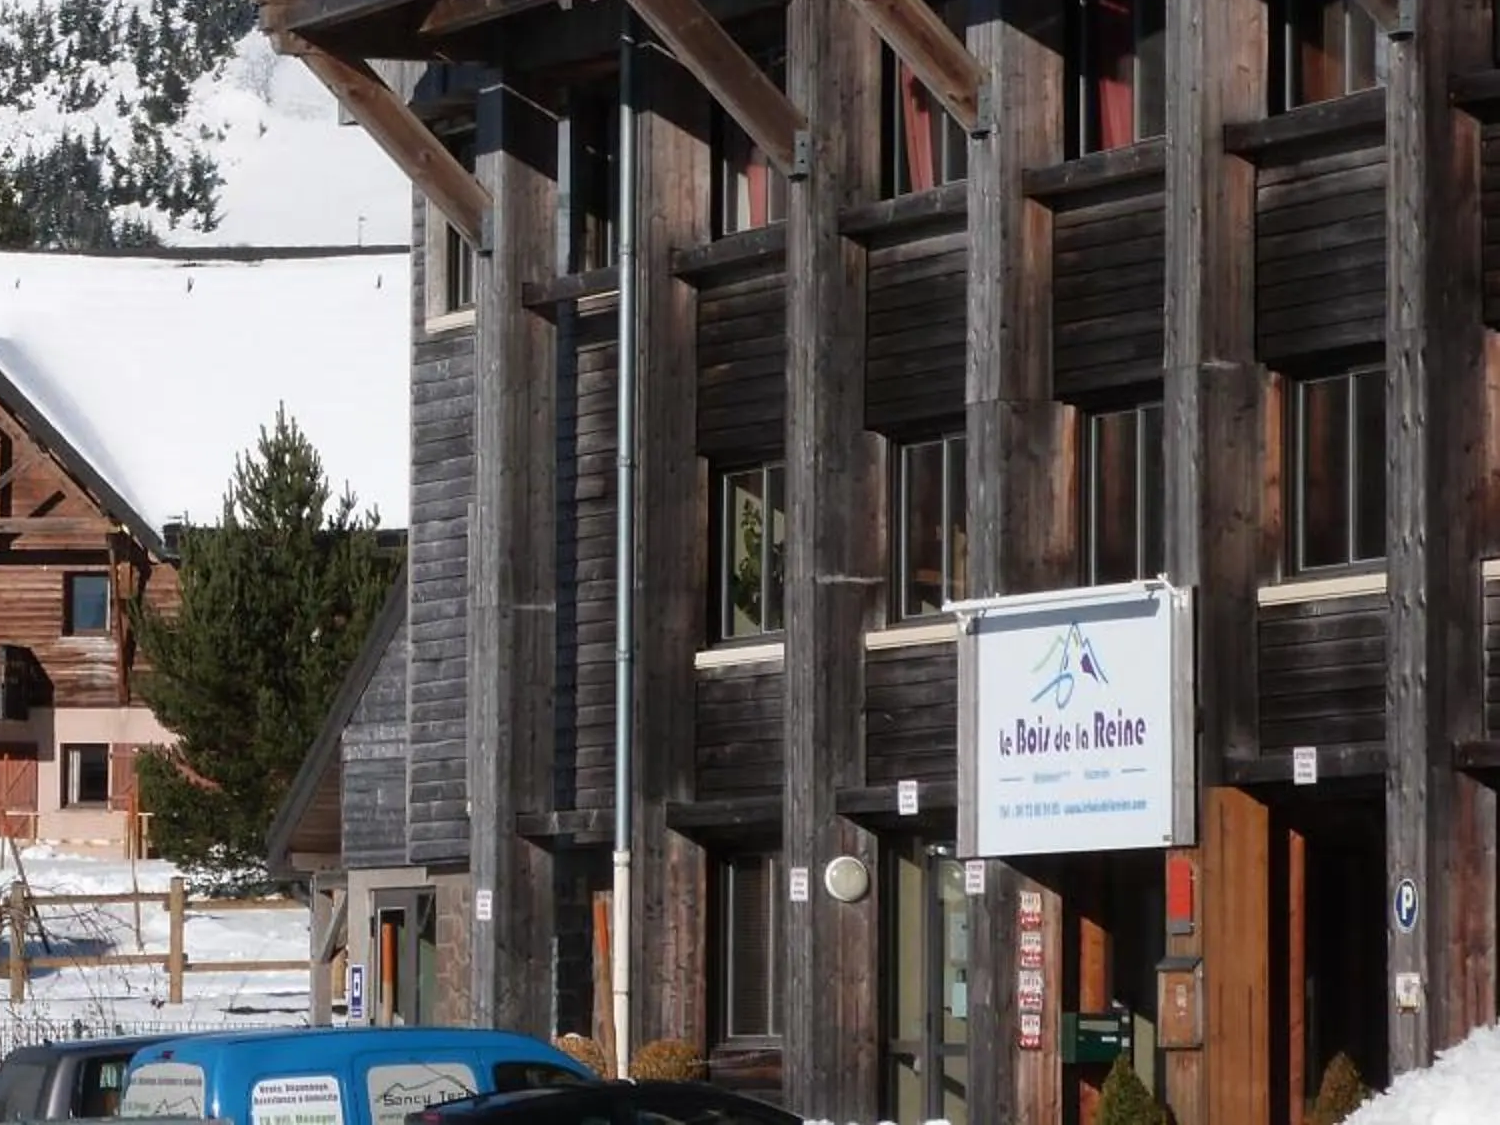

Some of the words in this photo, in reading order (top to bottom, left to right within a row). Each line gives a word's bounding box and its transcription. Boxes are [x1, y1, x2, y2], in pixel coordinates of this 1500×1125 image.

[1016, 715, 1050, 756] Bois
[1054, 724, 1071, 752] de
[1075, 722, 1089, 751] la
[1094, 708, 1146, 749] Reine
